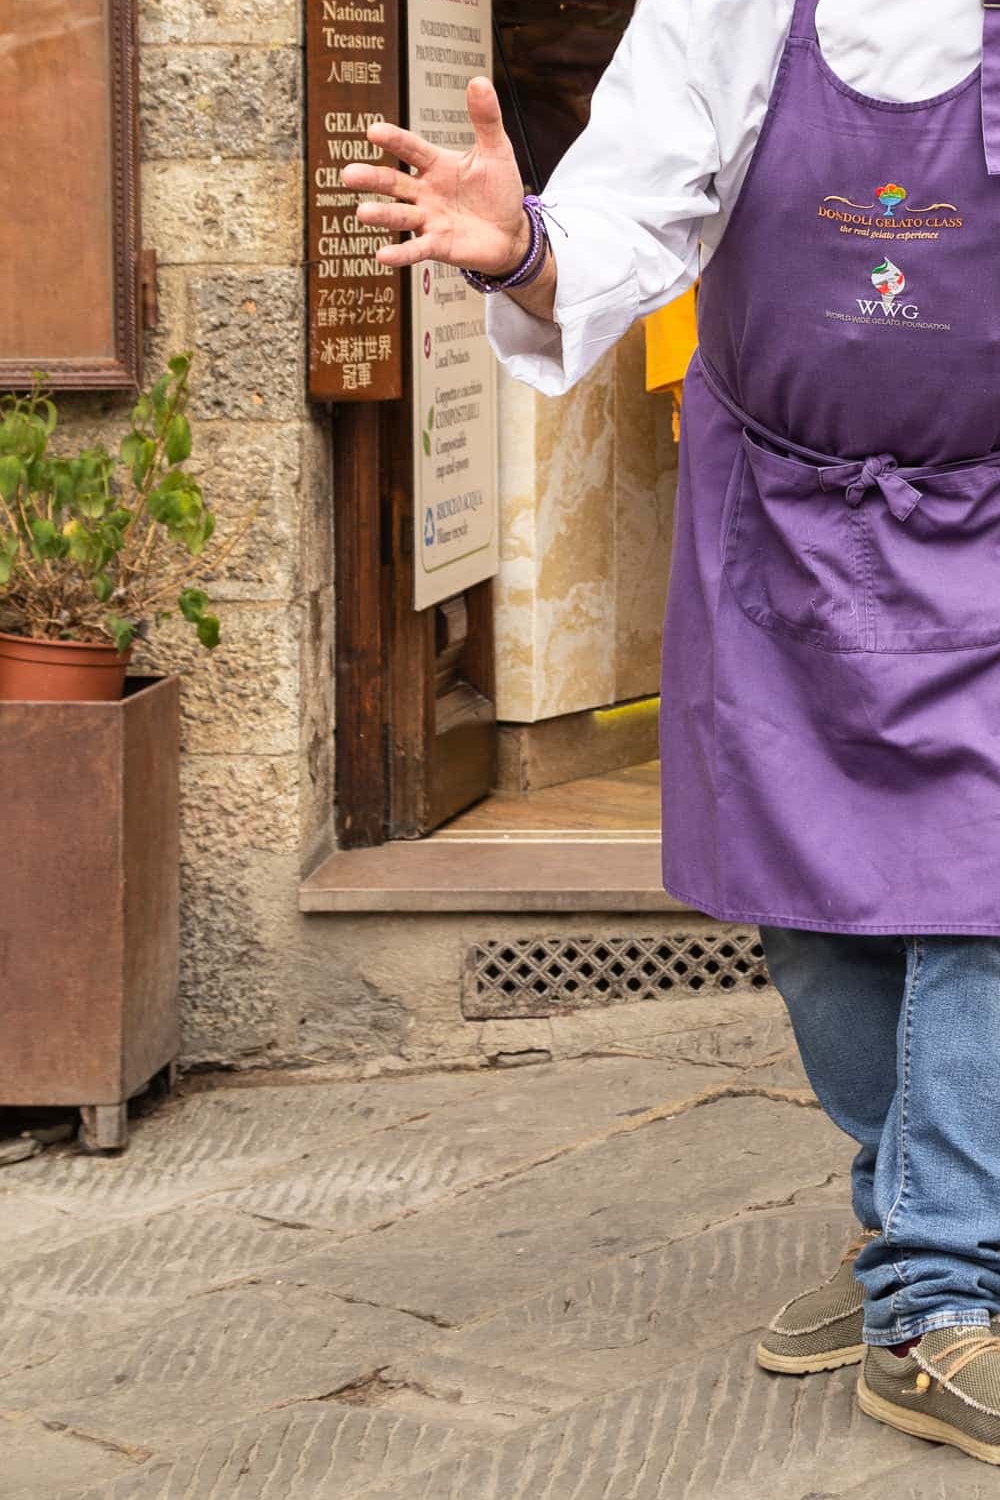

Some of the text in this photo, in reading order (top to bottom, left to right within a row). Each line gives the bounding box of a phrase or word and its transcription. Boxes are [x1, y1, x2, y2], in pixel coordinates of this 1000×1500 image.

[322, 0, 385, 23] National
[322, 27, 385, 50] Treasure
[327, 61, 382, 85] 人間国宝
[327, 140, 384, 160] WORLD
[322, 215, 340, 234] LA
[817, 206, 963, 229] DONDOLI GELATO CLASS
[840, 225, 852, 234] the
[870, 230, 895, 240] gelato
[319, 259, 340, 278] DU
[318, 286, 394, 306] アイスクリームの
[856, 298, 920, 319] WWG
[342, 362, 373, 390] 冠軍
